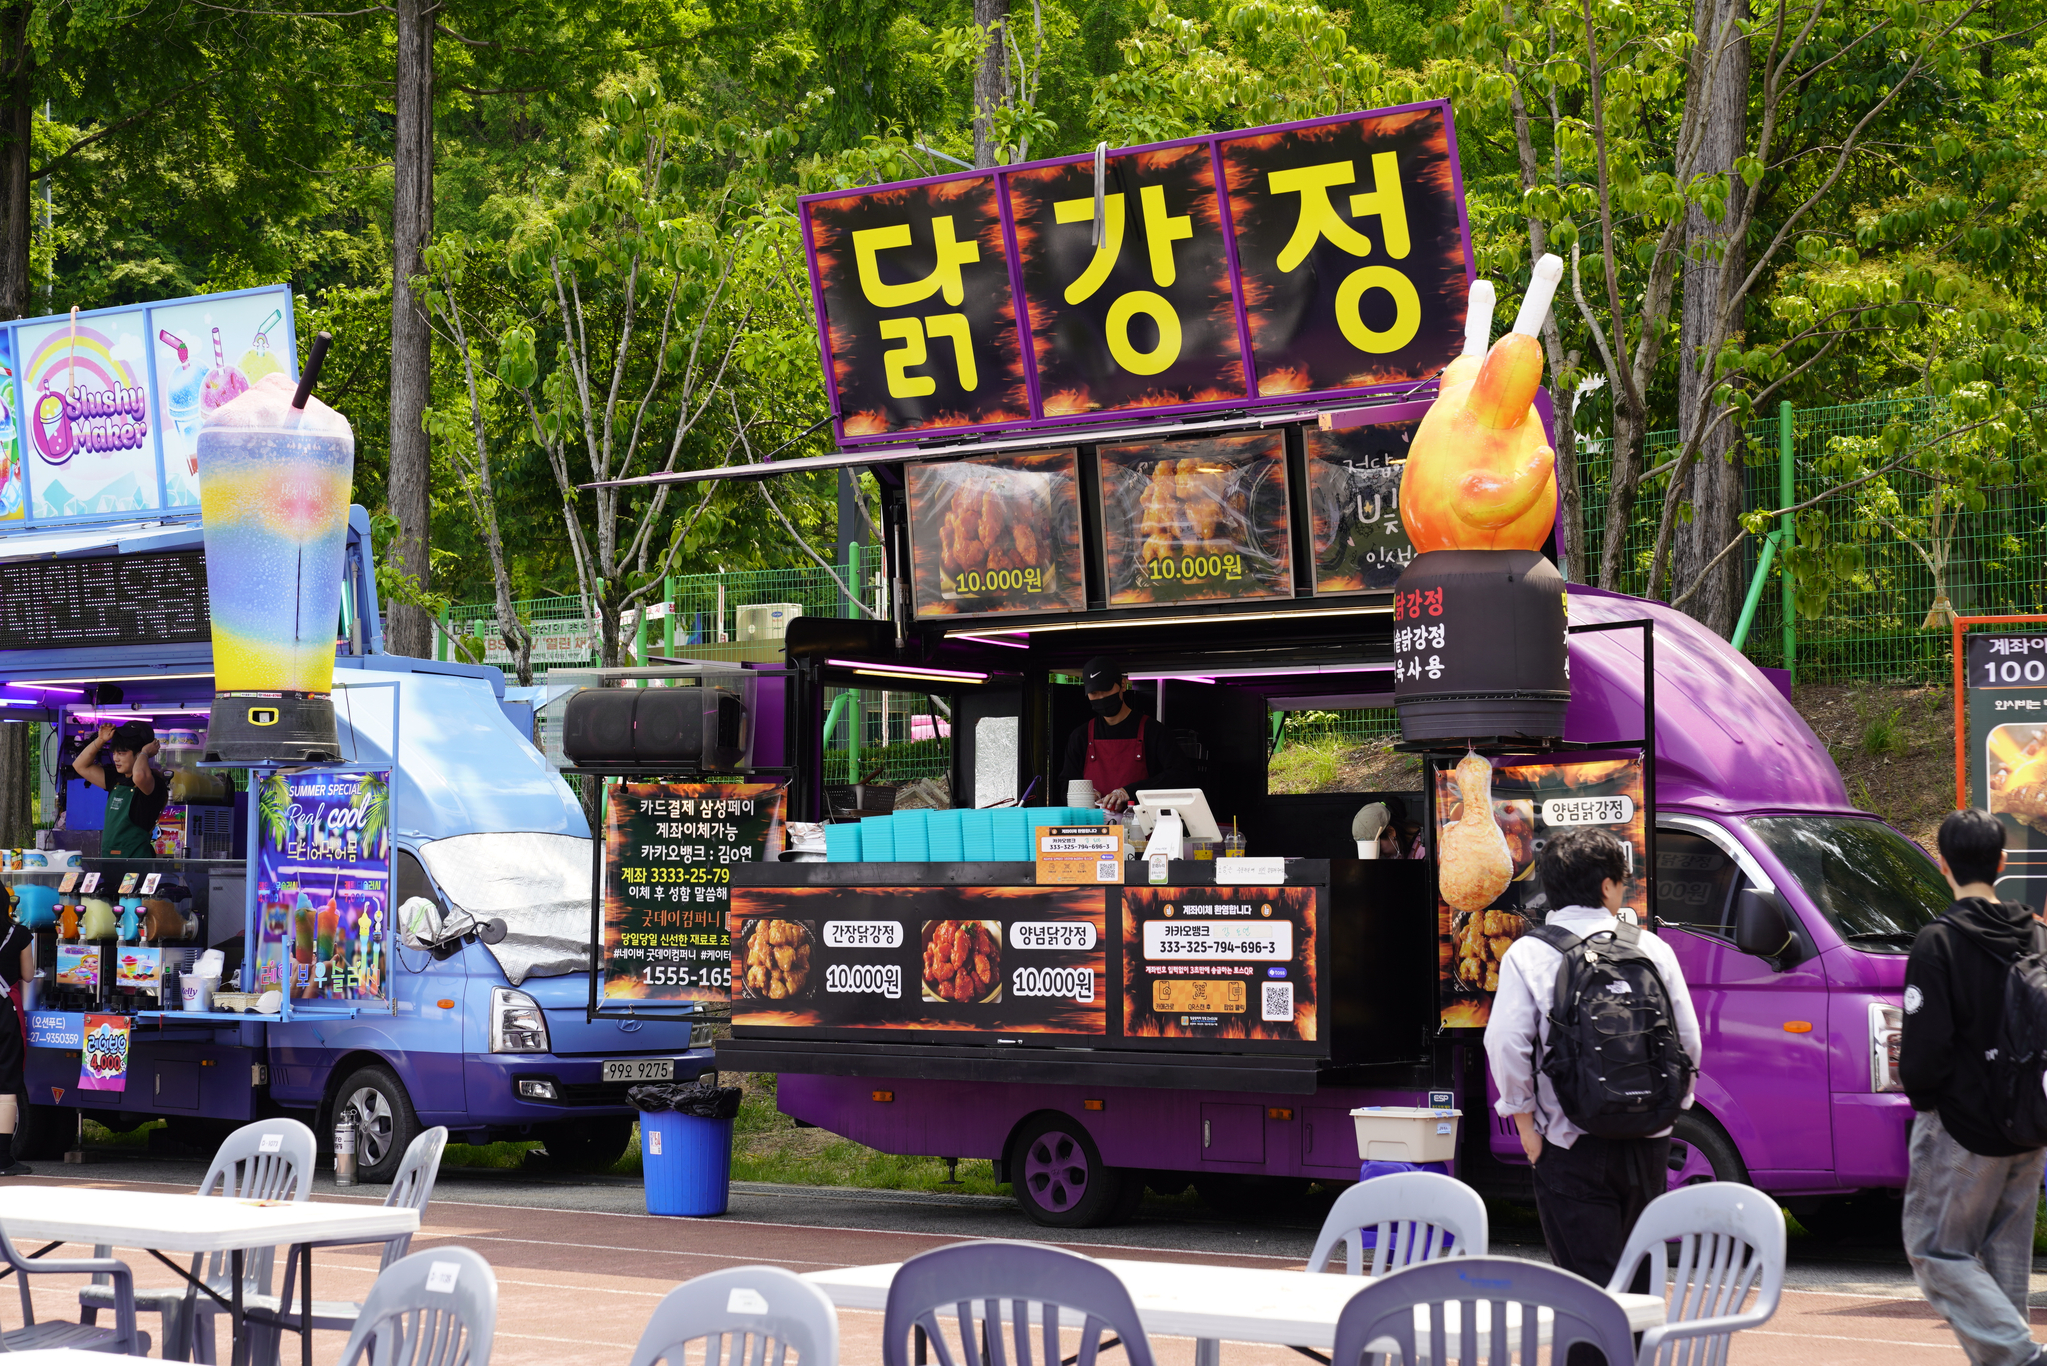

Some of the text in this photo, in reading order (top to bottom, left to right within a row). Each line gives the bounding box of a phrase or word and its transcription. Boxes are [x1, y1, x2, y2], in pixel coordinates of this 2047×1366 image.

[65, 381, 145, 421] Slushy
[70, 417, 147, 455] Maker
[1148, 554, 1243, 582] 10.000원
[955, 566, 1044, 595] 10.000원
[1407, 655, 1445, 681] 사용
[1984, 660, 2045, 683] 100
[289, 783, 362, 797] SUMMER SPECIAL
[287, 792, 372, 832] Real cool
[640, 800, 754, 818] 카드결제 삼성페이
[1552, 800, 1624, 821] 양념닭강정
[656, 822, 739, 841] 계좌이체가능
[641, 845, 706, 864] 카카오뱅크
[621, 868, 730, 884] 계좌 3333-25-79
[344, 893, 366, 903] 7,000
[629, 886, 728, 902] 이체 후 성함 말씀해
[642, 910, 720, 928] 굿데이컴퍼니
[1183, 904, 1252, 915] 계좌이체 환영합니다
[621, 933, 658, 946] 당일당일
[660, 933, 688, 946] 신선한
[690, 934, 718, 946] 재료로
[832, 925, 895, 944] 간장닭강정
[1019, 926, 1087, 946] 양념닭강정
[1165, 925, 1210, 937] 카카오뱅크
[613, 948, 645, 960] #네이버
[646, 949, 696, 962] 굿데이컴퍼니
[1160, 941, 1275, 953] 333-325-794-696-3
[828, 967, 900, 995] 10.000원
[1015, 970, 1093, 999] 10.000원
[32, 1016, 66, 1030] (오션푸드)
[87, 1034, 127, 1055] 레인보우
[90, 1054, 121, 1071] 4,000
[609, 1062, 668, 1079] 99오 9275
